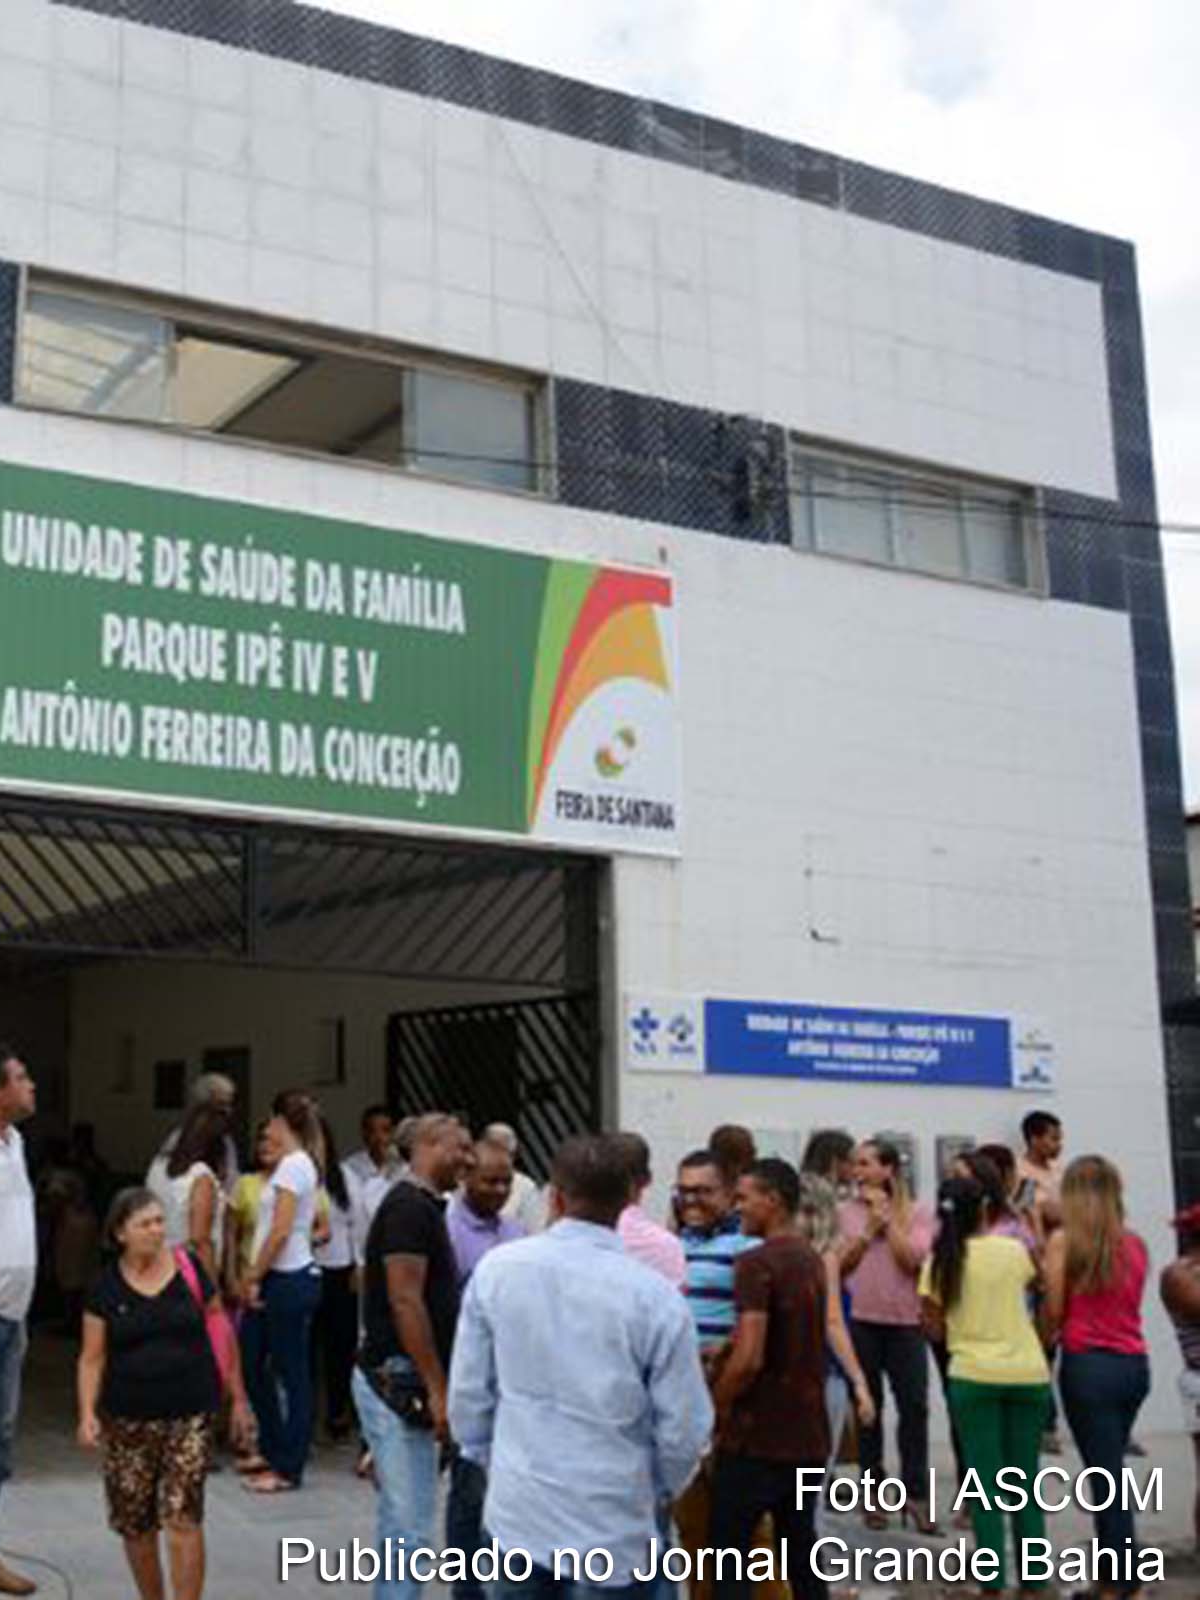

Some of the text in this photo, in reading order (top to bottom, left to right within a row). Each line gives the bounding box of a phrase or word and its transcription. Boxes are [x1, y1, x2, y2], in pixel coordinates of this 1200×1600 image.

[1, 509, 465, 635] UNIDADE DE SAÚDE DA FAMÍLIA
[102, 612, 378, 702] PARQUE IPÊ IV E V
[141, 704, 272, 774] FERREIRA
[280, 720, 316, 778] DA
[323, 726, 461, 808] CONCEIÇÃO
[555, 789, 675, 830] FEIRA DE SANTANA
